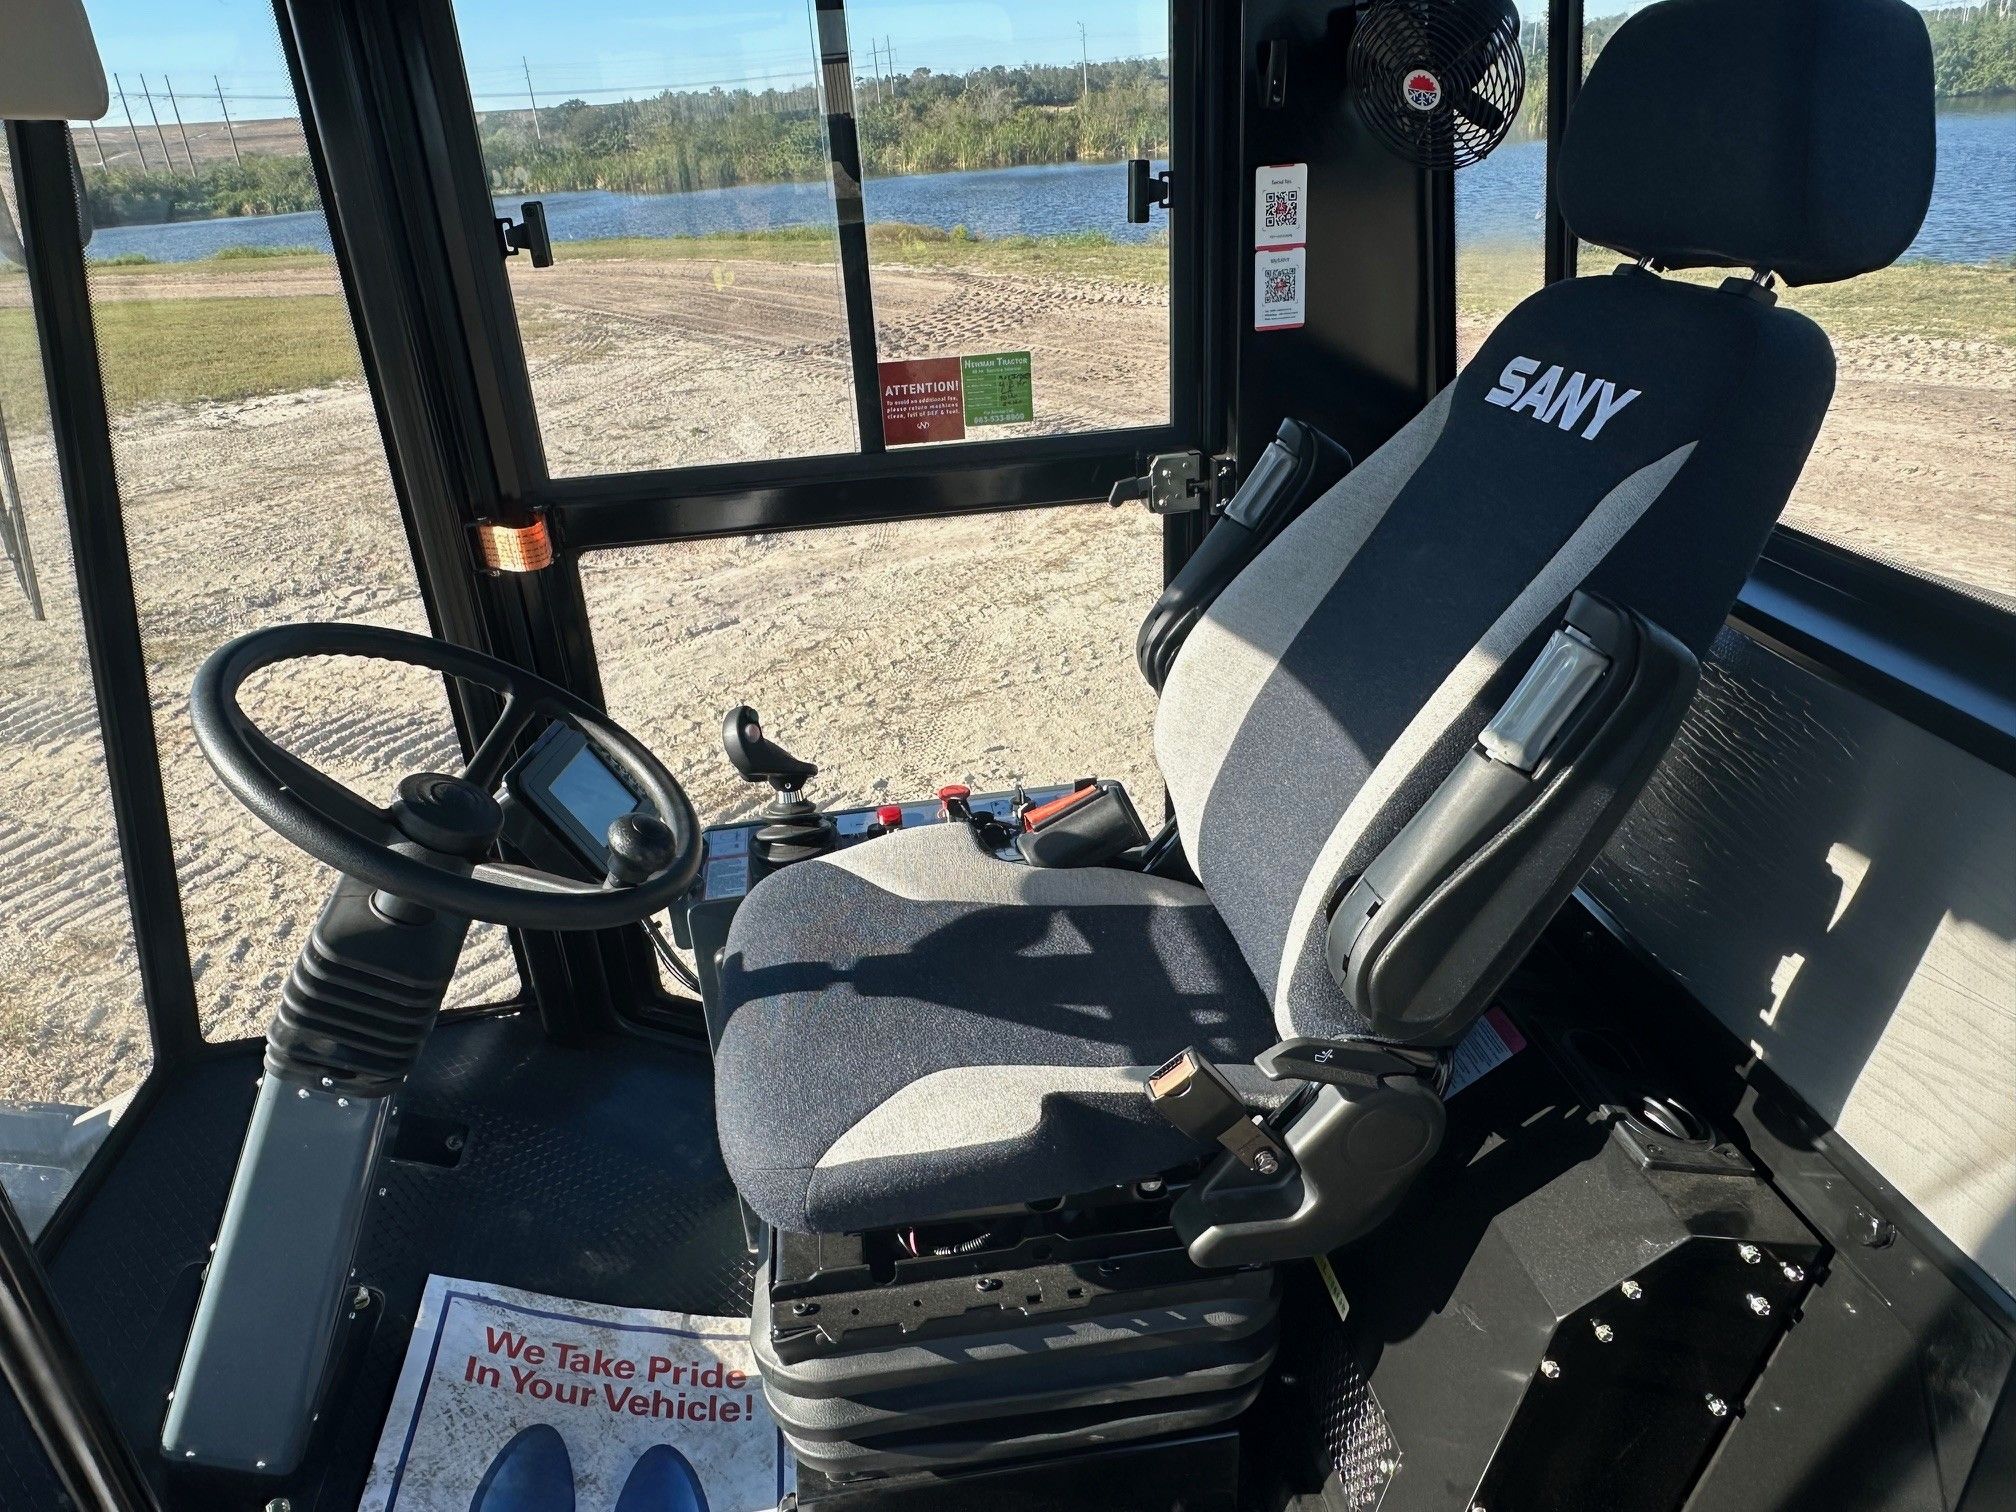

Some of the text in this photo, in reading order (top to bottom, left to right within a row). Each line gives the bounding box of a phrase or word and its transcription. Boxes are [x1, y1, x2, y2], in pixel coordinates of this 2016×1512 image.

[885, 380, 959, 397] ATTENTION!
[918, 396, 946, 404] additional
[1484, 355, 1642, 441] SANY
[886, 406, 907, 414] please
[486, 1326, 747, 1389] We Take Pride
[464, 1355, 753, 1423] In Your Vehicle!
